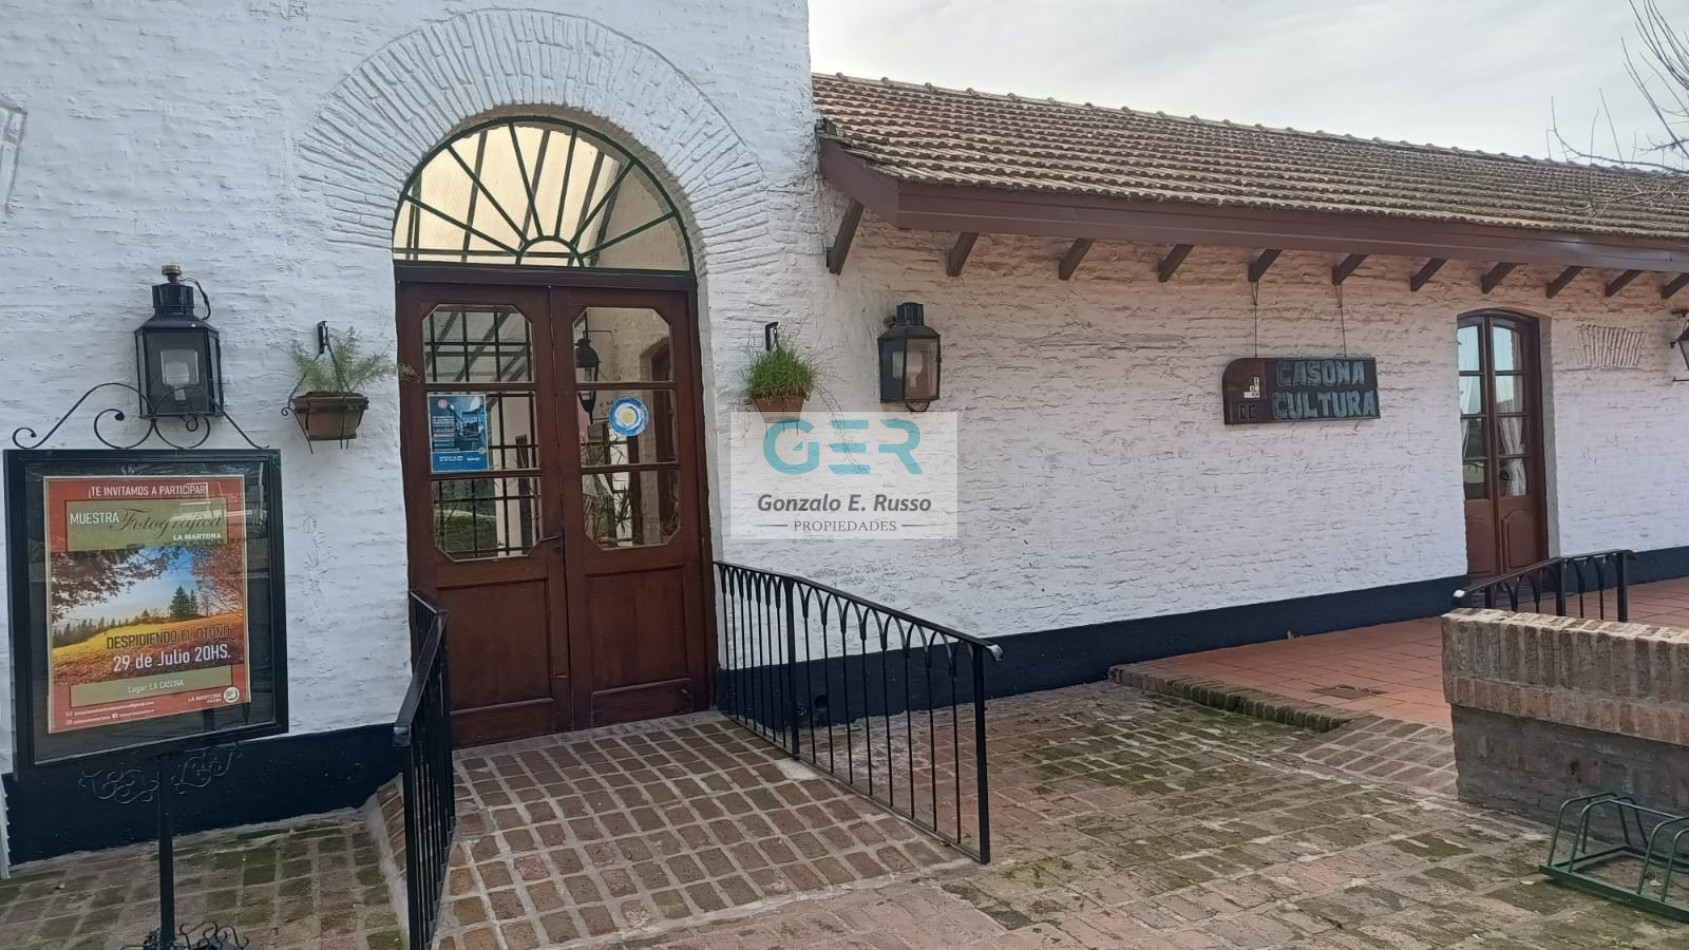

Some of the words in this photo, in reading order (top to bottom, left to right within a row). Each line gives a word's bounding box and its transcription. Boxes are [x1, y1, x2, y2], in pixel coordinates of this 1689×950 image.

[1276, 360, 1365, 387] CASONA
[1272, 390, 1376, 420] CULTURA
[104, 486, 149, 496] INVITAMOS
[151, 485, 158, 496] A
[70, 512, 120, 525] MUESTRA
[184, 532, 222, 540] MARTONA
[106, 630, 178, 650] DESPIDIENDO
[113, 655, 131, 672] 29
[135, 654, 153, 669] de
[157, 650, 190, 667] Julio
[194, 643, 231, 663] 20HS.
[149, 682, 159, 691] LA
